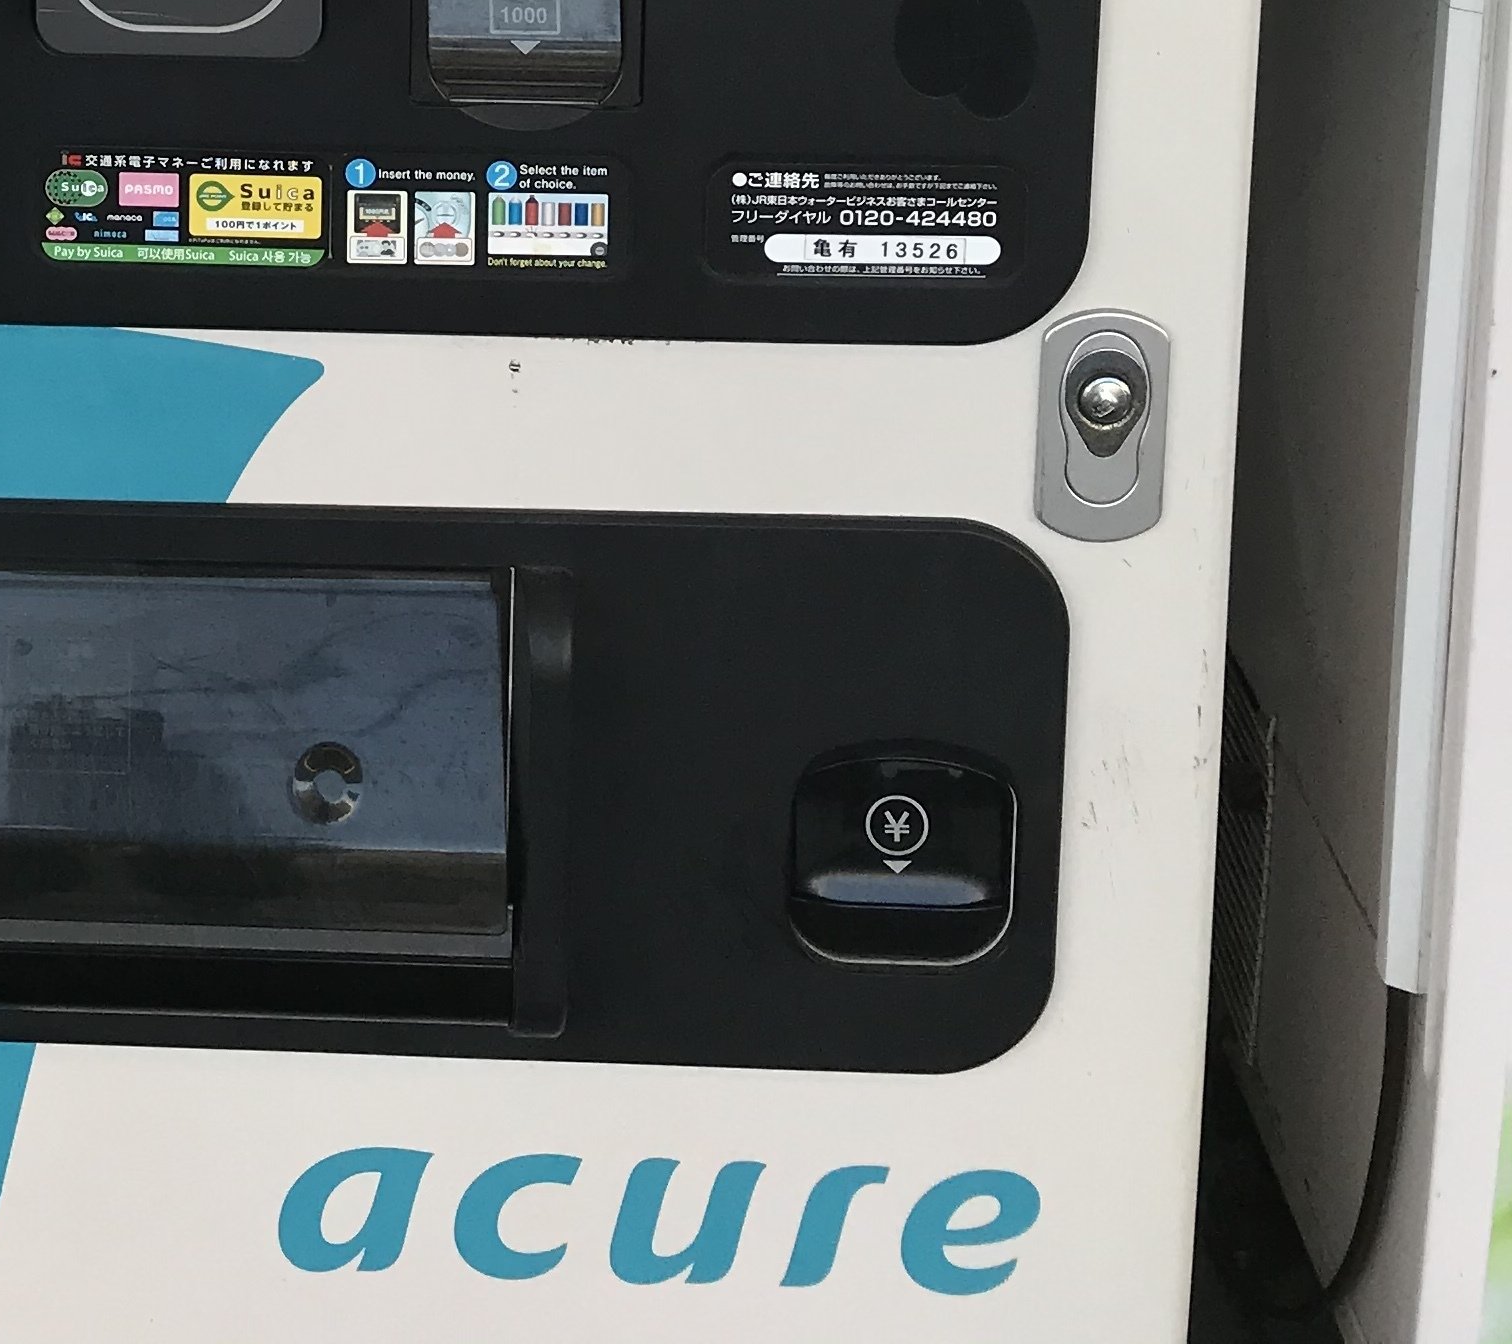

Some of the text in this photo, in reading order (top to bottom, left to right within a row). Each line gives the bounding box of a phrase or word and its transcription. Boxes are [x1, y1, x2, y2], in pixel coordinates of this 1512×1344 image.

[499, 4, 548, 26] 1000
[85, 154, 314, 172] 交通系電子マネーご利用になれます
[519, 164, 558, 176] Select
[560, 165, 579, 176] the
[582, 165, 608, 177] item
[378, 168, 411, 180] Insert
[414, 169, 433, 180] the
[435, 171, 476, 183] money.
[748, 172, 820, 189] ご連絡先
[124, 183, 174, 195] PASMO
[519, 178, 577, 190] of choice.
[239, 183, 315, 201] Suica
[240, 200, 314, 213] 登録して貯まる
[730, 194, 998, 208] (株)JR東日本ウォータービジネスお客さまコールセンター
[214, 220, 297, 231] 100円で1ポイント
[730, 209, 997, 228] フリーダイヤル 0120-424480
[53, 245, 124, 260] Pay by Suica
[137, 247, 215, 261] 可以使用Suica
[812, 238, 858, 259] 亀有
[880, 241, 959, 260] 13526
[229, 249, 312, 265] Suica 사용 가능
[487, 257, 608, 269] Don't forget about your change.
[277, 1146, 1042, 1297] acure
